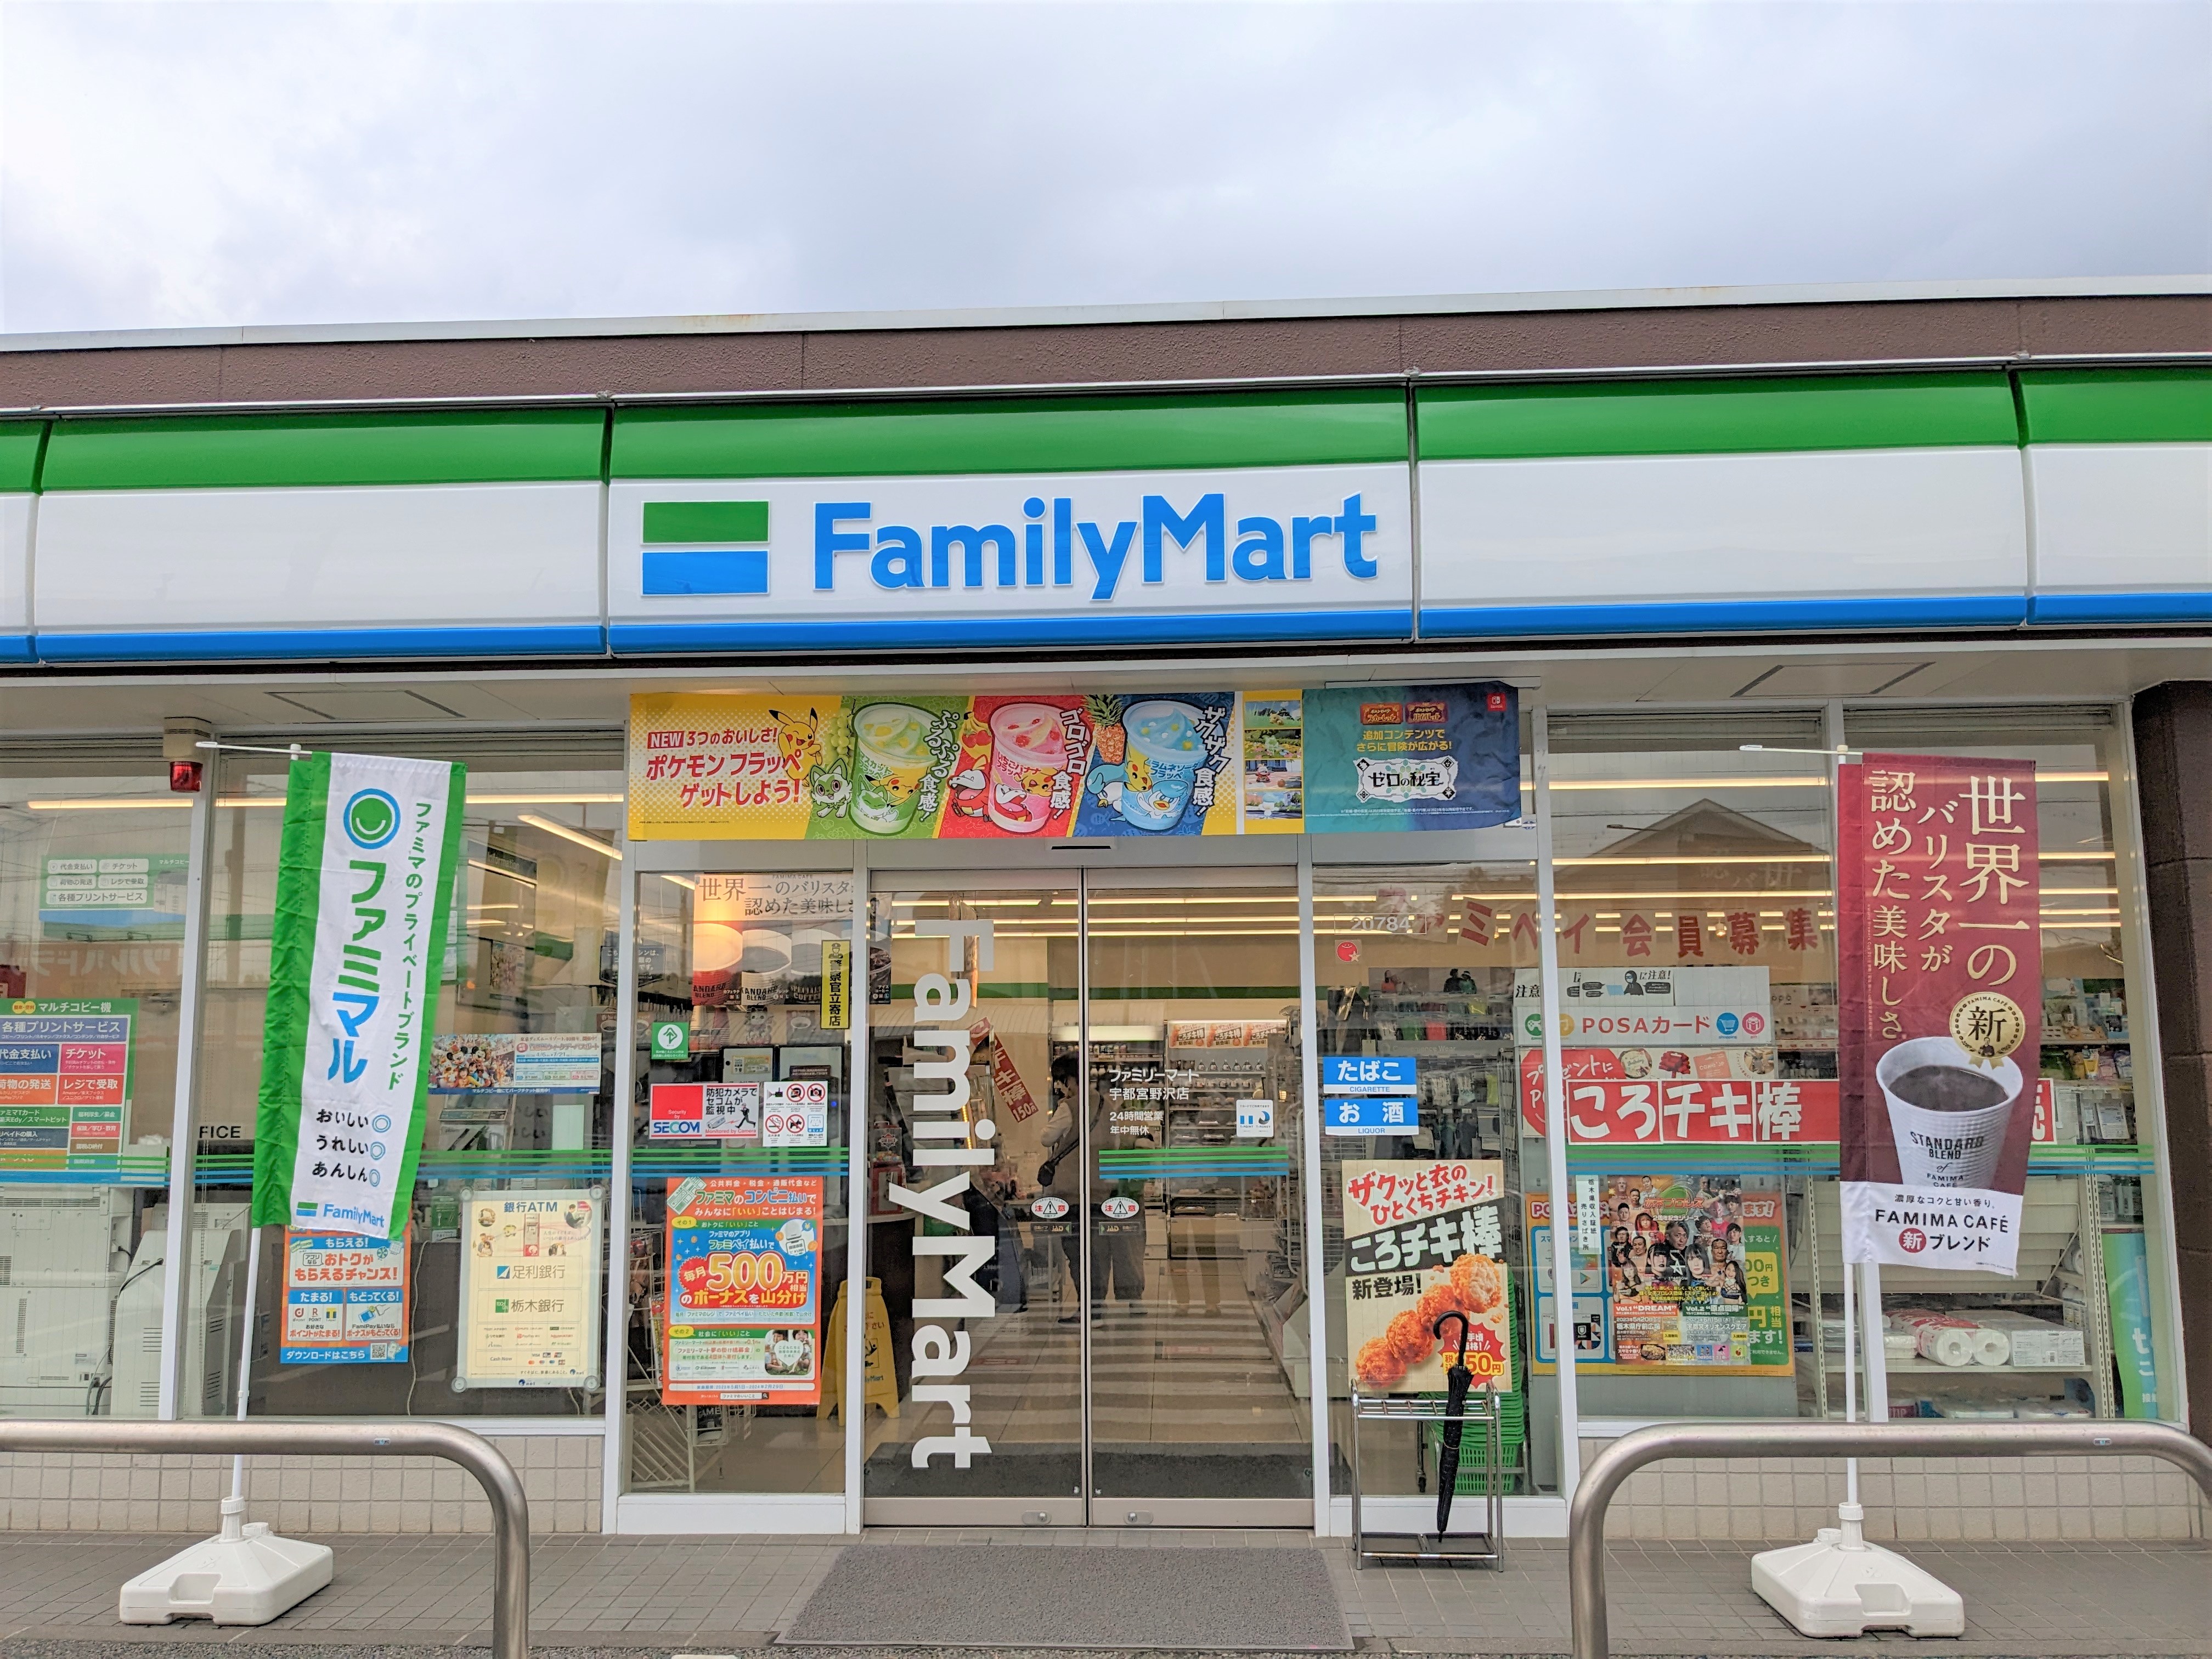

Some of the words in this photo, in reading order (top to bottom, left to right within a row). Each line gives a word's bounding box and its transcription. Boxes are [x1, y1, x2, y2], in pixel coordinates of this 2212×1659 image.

[814, 493, 1380, 601] FamilyMart
[651, 733, 681, 748] NEW
[687, 727, 778, 746] 3つのおいしさ!
[1363, 729, 1446, 741] 追加コンテンツで
[1356, 741, 1452, 752] さらに冒険が広がる!
[859, 760, 885, 780] フラッペ
[860, 751, 894, 776] マスカット
[996, 761, 1023, 780] フラッペ
[997, 751, 1041, 775] いちごバナナ
[1151, 760, 1199, 771] ラムネソーダ
[1150, 769, 1183, 779] フラッペ
[1367, 770, 1444, 788] ゼロの秘宝
[680, 778, 800, 808] ゲットしよう!
[1917, 800, 1959, 973] バリスタが
[1959, 775, 2029, 986] 世界一の
[58, 893, 144, 902] 各種プリントサービス
[699, 878, 854, 901] 世界一のバリスタ
[1869, 769, 1916, 1040] 認めた美味しさ
[1351, 916, 1410, 932] 20784
[388, 802, 432, 1091] ファミマのプライベートブランド
[328, 860, 387, 1084] ファミマル
[1639, 970, 1672, 980] に注意!
[829, 960, 842, 1026] 警察官立寄店
[38, 1002, 112, 1013] マルチコピー機
[1967, 996, 1991, 1005] FAMIMA
[1993, 997, 2008, 1007] CAFÉ
[2, 1020, 121, 1032] 各種プリントサービス
[1582, 1015, 1711, 1035] POSAカード
[1967, 1006, 2007, 1042] 新
[0, 1048, 52, 1059] 代金支払い
[65, 1048, 106, 1059] チケット
[1109, 1068, 1199, 1083] ファミリーマート
[1338, 1060, 1401, 1082] たばこ
[64, 1079, 118, 1090] レジで受取
[706, 1088, 758, 1097] 防犯カメラで
[706, 1097, 743, 1105] セコムが
[1109, 1087, 1189, 1101] 宇都宮野沢店
[316, 1108, 369, 1128] おいしい
[706, 1105, 736, 1115] 監視中
[1109, 1110, 1164, 1121] 24時間営業
[1570, 1082, 1802, 1141] ころチキ棒
[653, 1121, 700, 1133] SECOM
[1110, 1125, 1150, 1136] 年中無休
[316, 1135, 369, 1155] うれしい
[1910, 1131, 1984, 1150] STANDARD
[1928, 1148, 1962, 1160] BLEND
[312, 1161, 368, 1182] あんしん
[1936, 1162, 1953, 1173] of
[1348, 1164, 1467, 1207] ザクッと衣の
[1927, 1173, 1964, 1182] FAMIMA
[695, 1189, 817, 1205] ファミマのコンビニ払いで
[889, 920, 996, 1468] FamilyMart
[1370, 1175, 1495, 1225] ひとくちチキン!
[1894, 1194, 1995, 1209] 濃厚なコクと甘い香り。
[504, 1201, 558, 1214] 銀行ATM
[1588, 1178, 1597, 1234] 栃木県収入証紙
[1644, 1197, 1705, 1209] 栃木プロレス
[1743, 1201, 1774, 1216] ます!
[323, 1204, 385, 1228] FamilyMart
[695, 1207, 816, 1216] みんなに「いい」ことはじまる!
[1581, 1203, 1589, 1251] 売りさばき所
[1875, 1209, 1959, 1227] FAMIMA
[1963, 1215, 2008, 1234] CAFÉ
[325, 1238, 369, 1248] もらえる!
[708, 1239, 775, 1250] ファミペイ払いで
[1350, 1206, 1503, 1272] ころチキ棒
[1903, 1232, 1922, 1250] 新
[1929, 1234, 1991, 1252] ブレンド
[324, 1253, 374, 1267] おトクが
[295, 1267, 398, 1282] もらえるチャンス!
[512, 1265, 566, 1279] 足利銀行
[684, 1266, 707, 1282] 毎月
[707, 1252, 784, 1292] 500
[782, 1271, 809, 1284] 万円
[1352, 1273, 1422, 1300] 新登場!
[1747, 1276, 1770, 1287] つき
[300, 1292, 332, 1302] たまる!
[349, 1291, 399, 1302] もどってくる!
[681, 1288, 807, 1305] のボーナスを山分け
[511, 1299, 565, 1313] 栃木銀行
[1770, 1306, 1782, 1328] 相当
[289, 1329, 340, 1338] ポイントがたまる!
[347, 1329, 401, 1338] ボーナスがもどってくる!
[1749, 1329, 1783, 1345] ます!
[286, 1350, 365, 1360] ダウンロードはこちら
